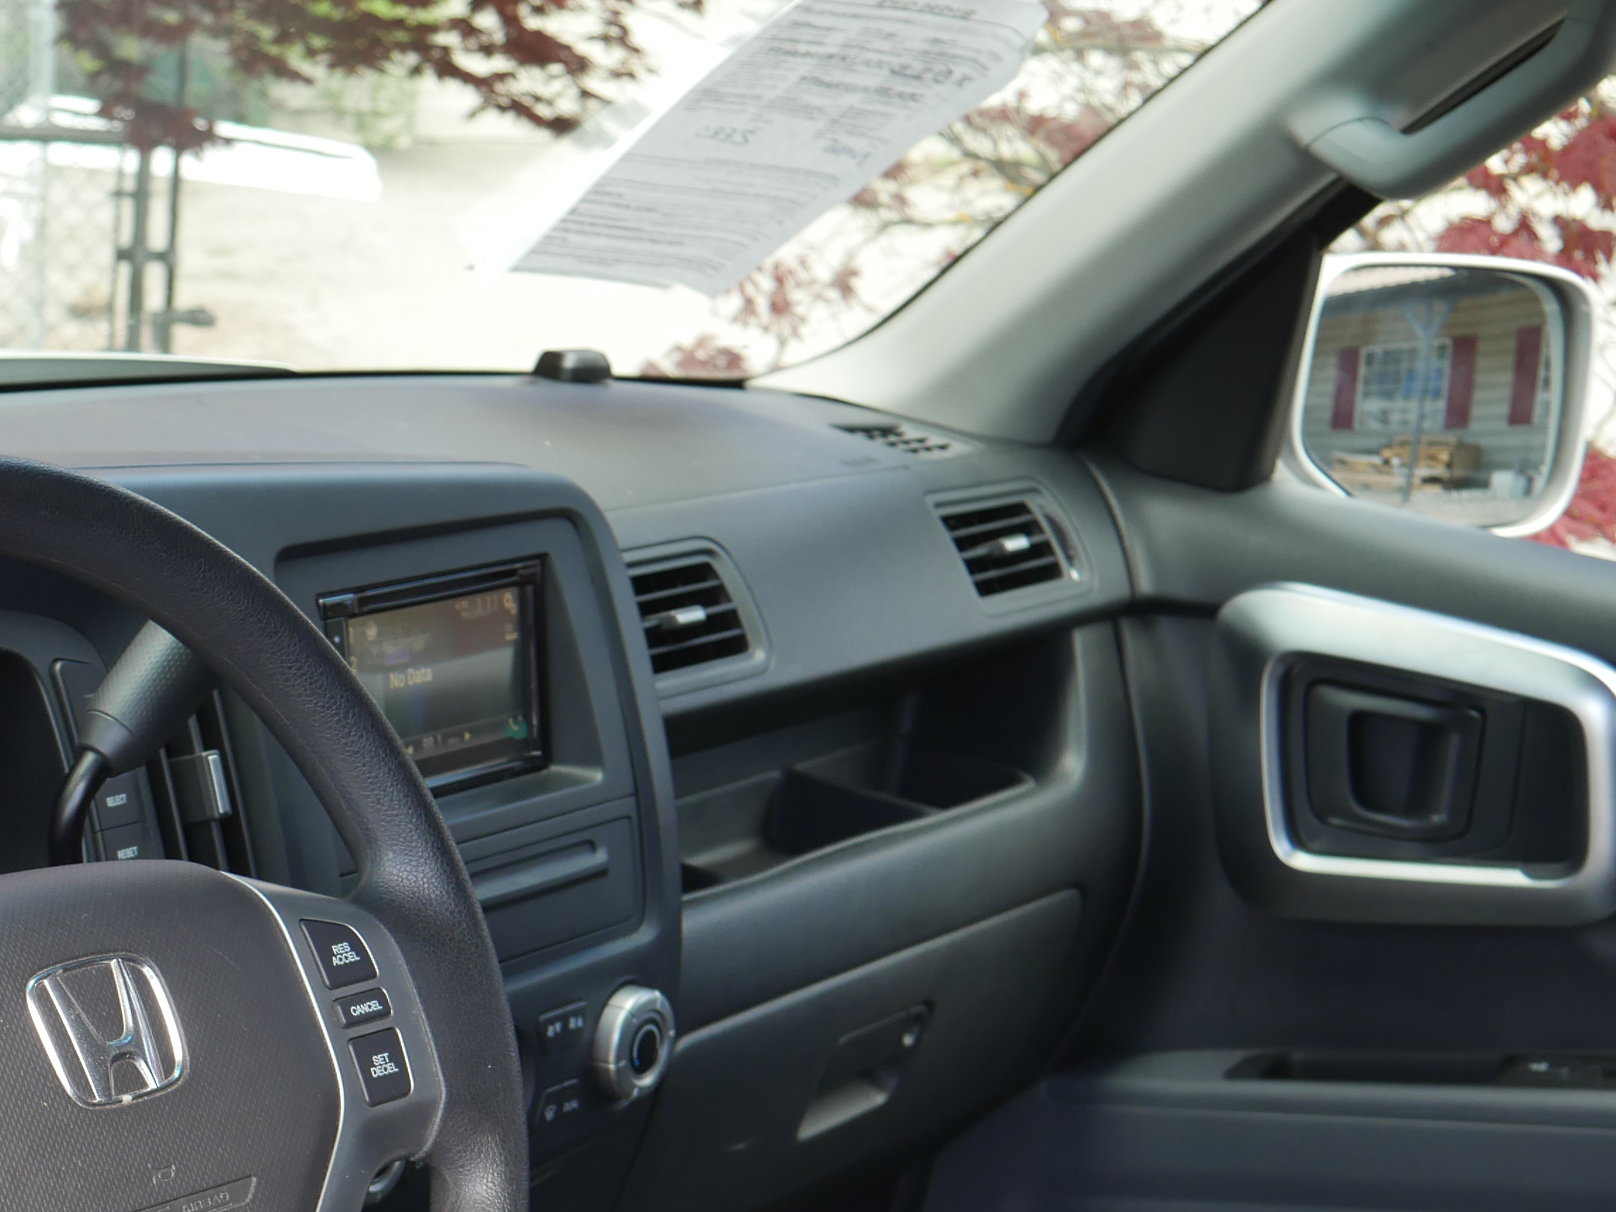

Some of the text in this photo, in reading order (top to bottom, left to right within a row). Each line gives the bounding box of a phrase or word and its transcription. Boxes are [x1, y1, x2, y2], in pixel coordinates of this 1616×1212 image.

[389, 667, 433, 689] No Data
[117, 845, 139, 860] RESET
[331, 942, 351, 955] RES
[332, 951, 361, 967] ACCEL
[350, 1000, 383, 1017] CANCEL
[371, 1053, 390, 1067] SET
[370, 1062, 400, 1079] DECEL
